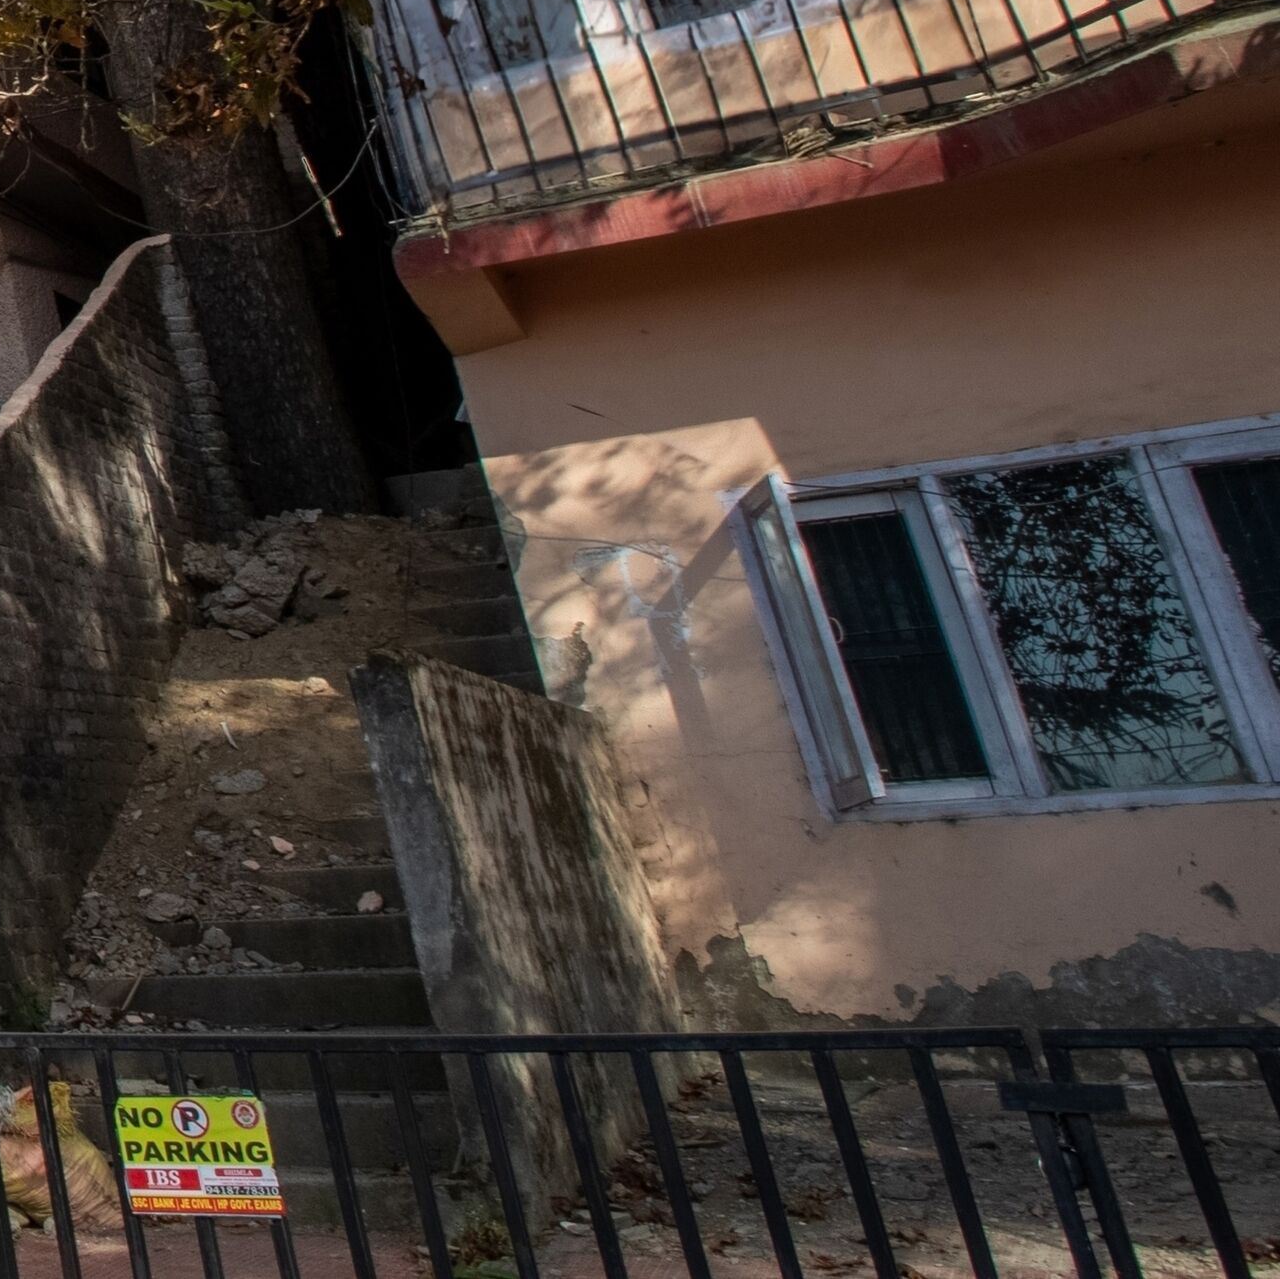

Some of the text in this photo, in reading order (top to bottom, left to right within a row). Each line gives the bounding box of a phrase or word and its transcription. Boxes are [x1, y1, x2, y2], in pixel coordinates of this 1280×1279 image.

[118, 1107, 163, 1128] NO
[124, 1141, 269, 1163] PARKING
[145, 1169, 181, 1186] IBS
[206, 1186, 279, 1195] 94187-78310
[133, 1198, 148, 1208] SSC
[153, 1198, 175, 1208] BANK
[180, 1199, 190, 1209] JE
[191, 1199, 213, 1209] CIVIL
[217, 1199, 229, 1209] HP
[254, 1200, 282, 1211] EXAMS
